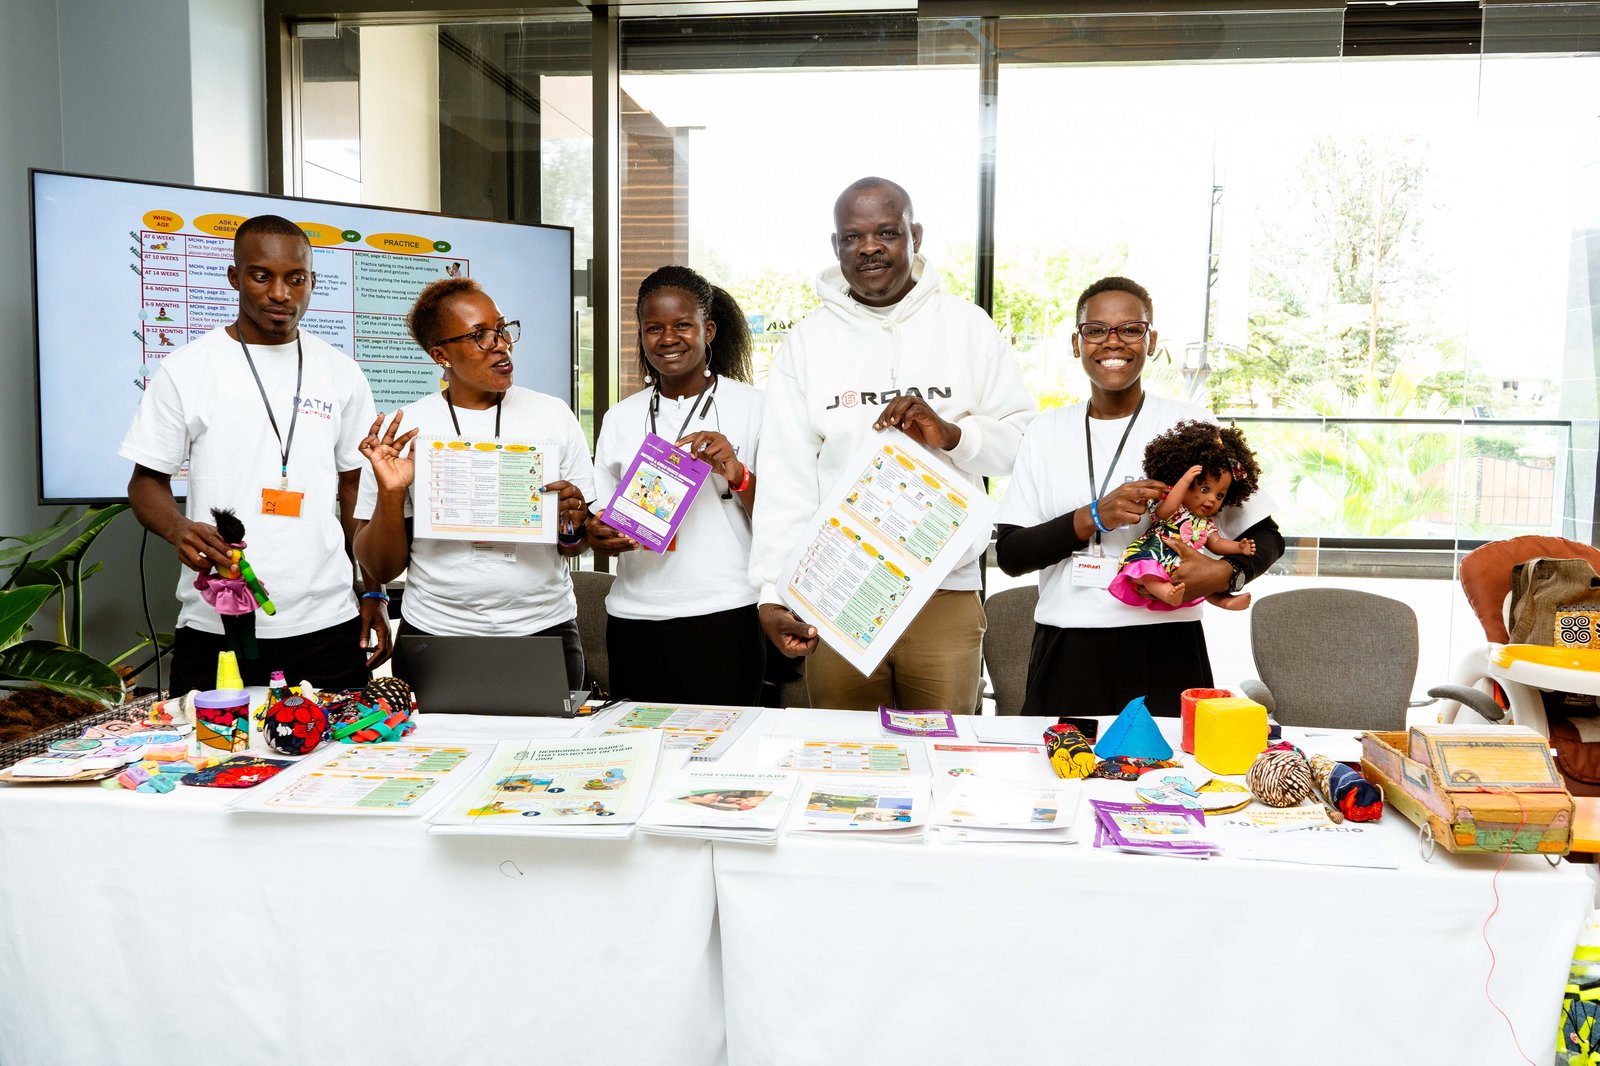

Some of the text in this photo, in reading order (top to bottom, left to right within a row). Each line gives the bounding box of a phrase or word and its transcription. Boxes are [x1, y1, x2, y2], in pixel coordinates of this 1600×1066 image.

[384, 239, 420, 248] PRACTICE
[294, 396, 332, 413] PATH
[826, 387, 952, 410] JORDAN
[266, 501, 276, 514] 12
